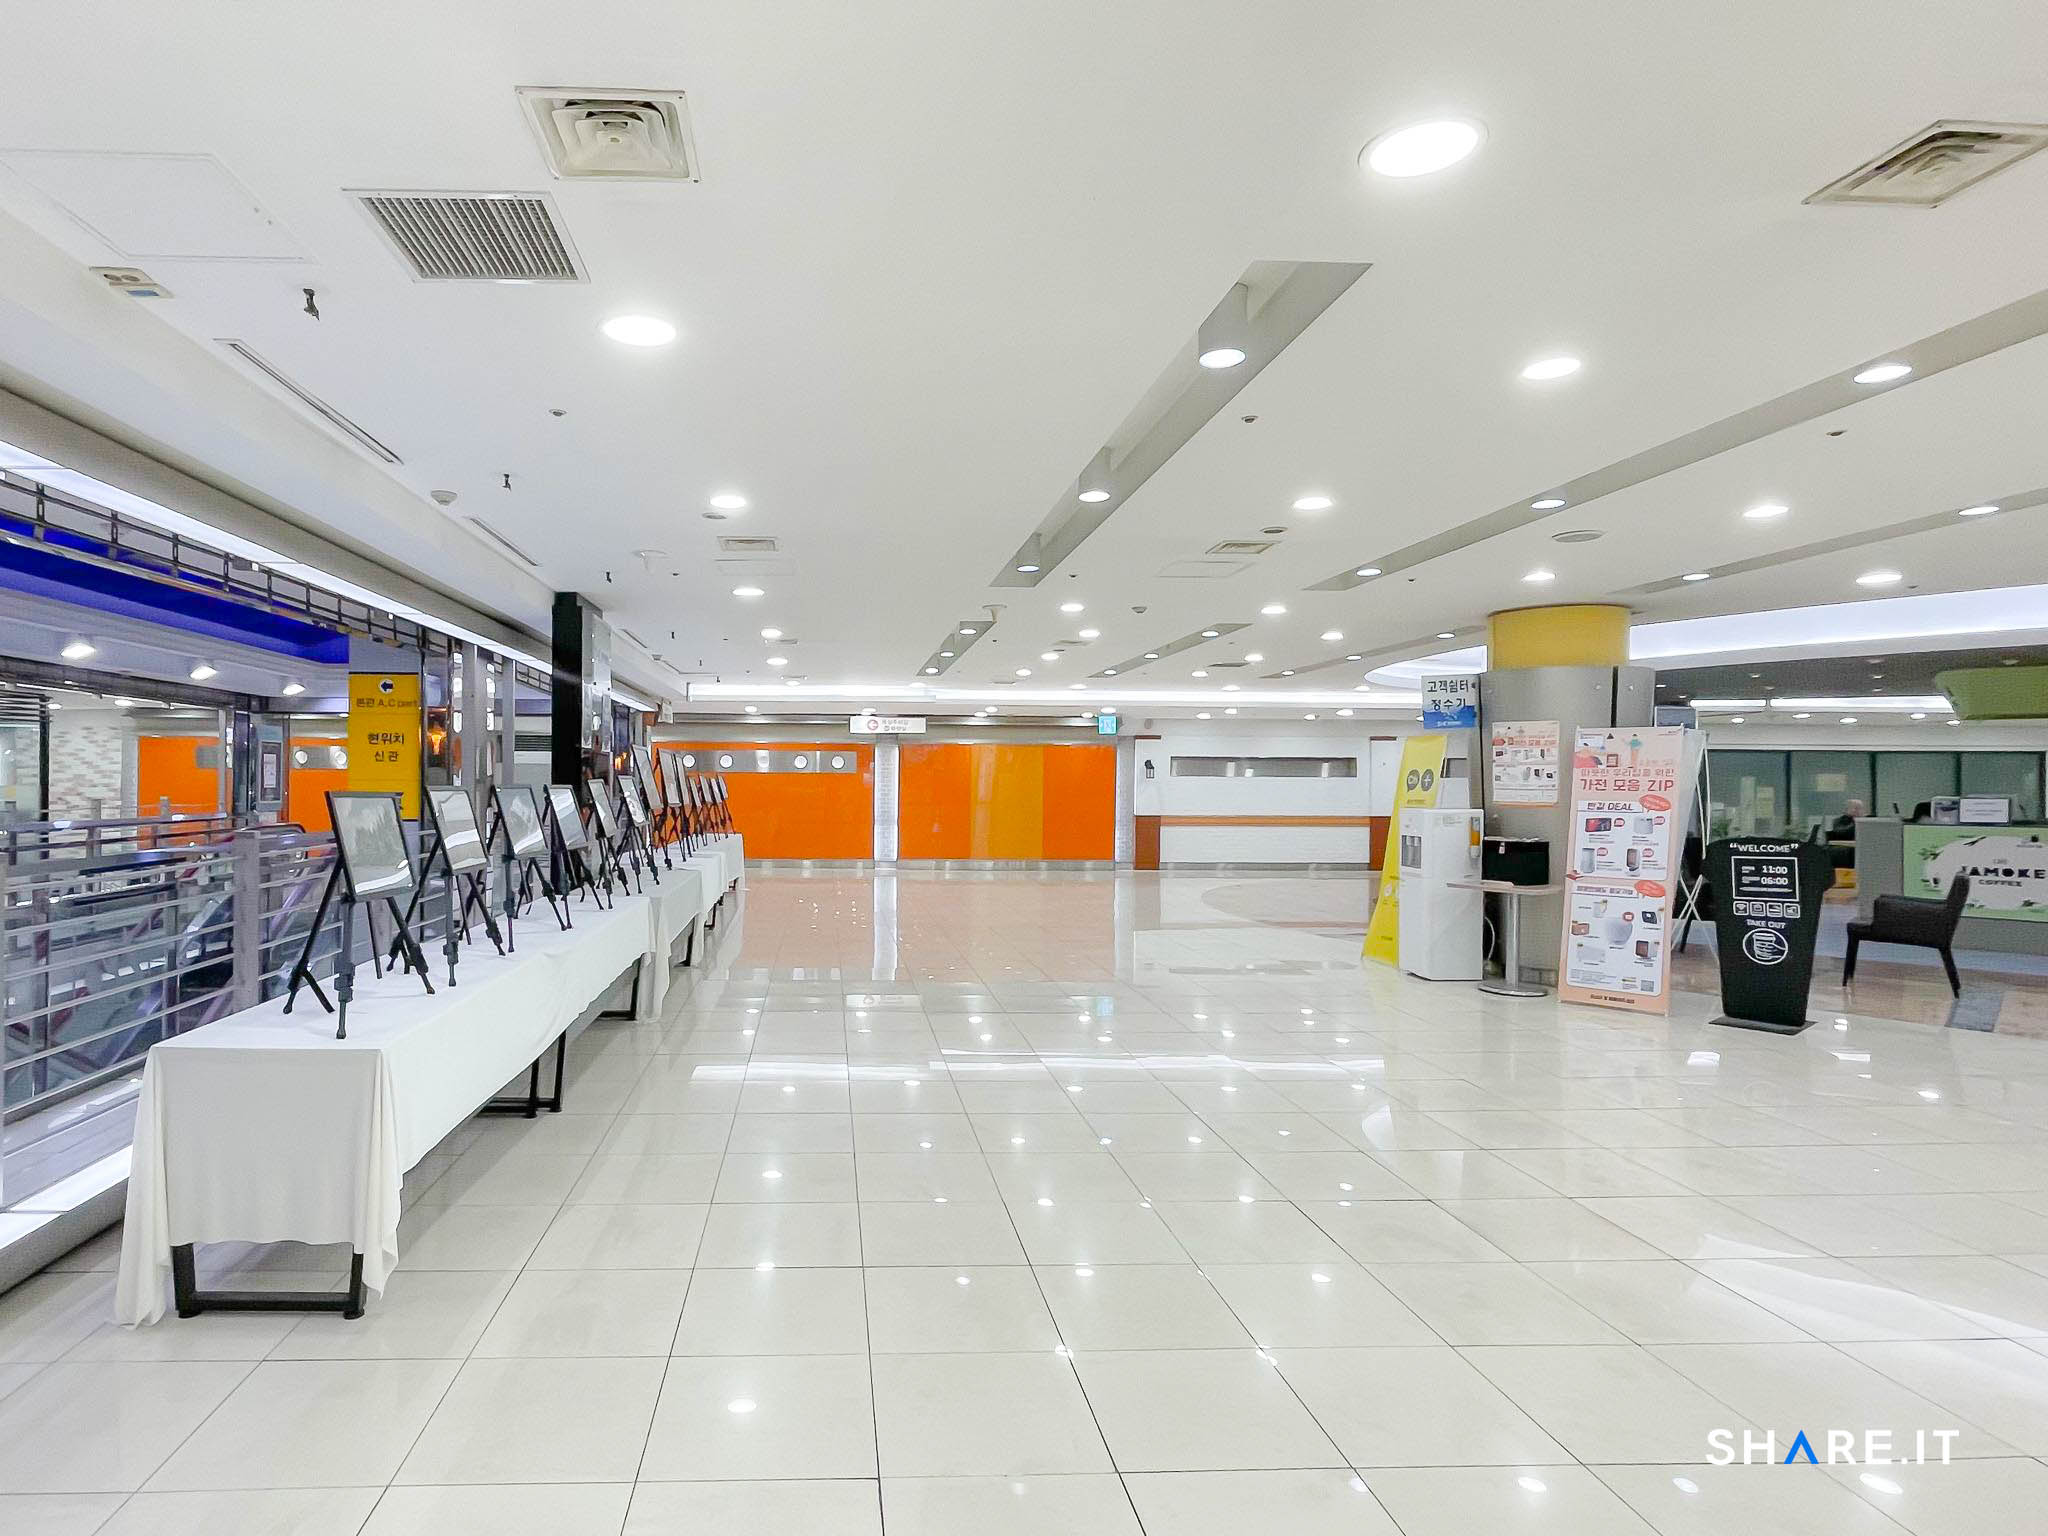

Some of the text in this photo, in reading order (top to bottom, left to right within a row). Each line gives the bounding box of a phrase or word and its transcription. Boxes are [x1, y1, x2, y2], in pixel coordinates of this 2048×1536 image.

[1427, 679, 1469, 693] 고객쉼터
[1431, 697, 1466, 711] 정수기
[368, 733, 405, 745] 현위치
[1580, 779, 1674, 792] 가전 모음 ZIP
[1607, 802, 1634, 811] DEAL
[1762, 865, 1788, 875] 11:00
[1979, 879, 2023, 888] COFFEE
[1746, 919, 1786, 929] TAKE OUT
